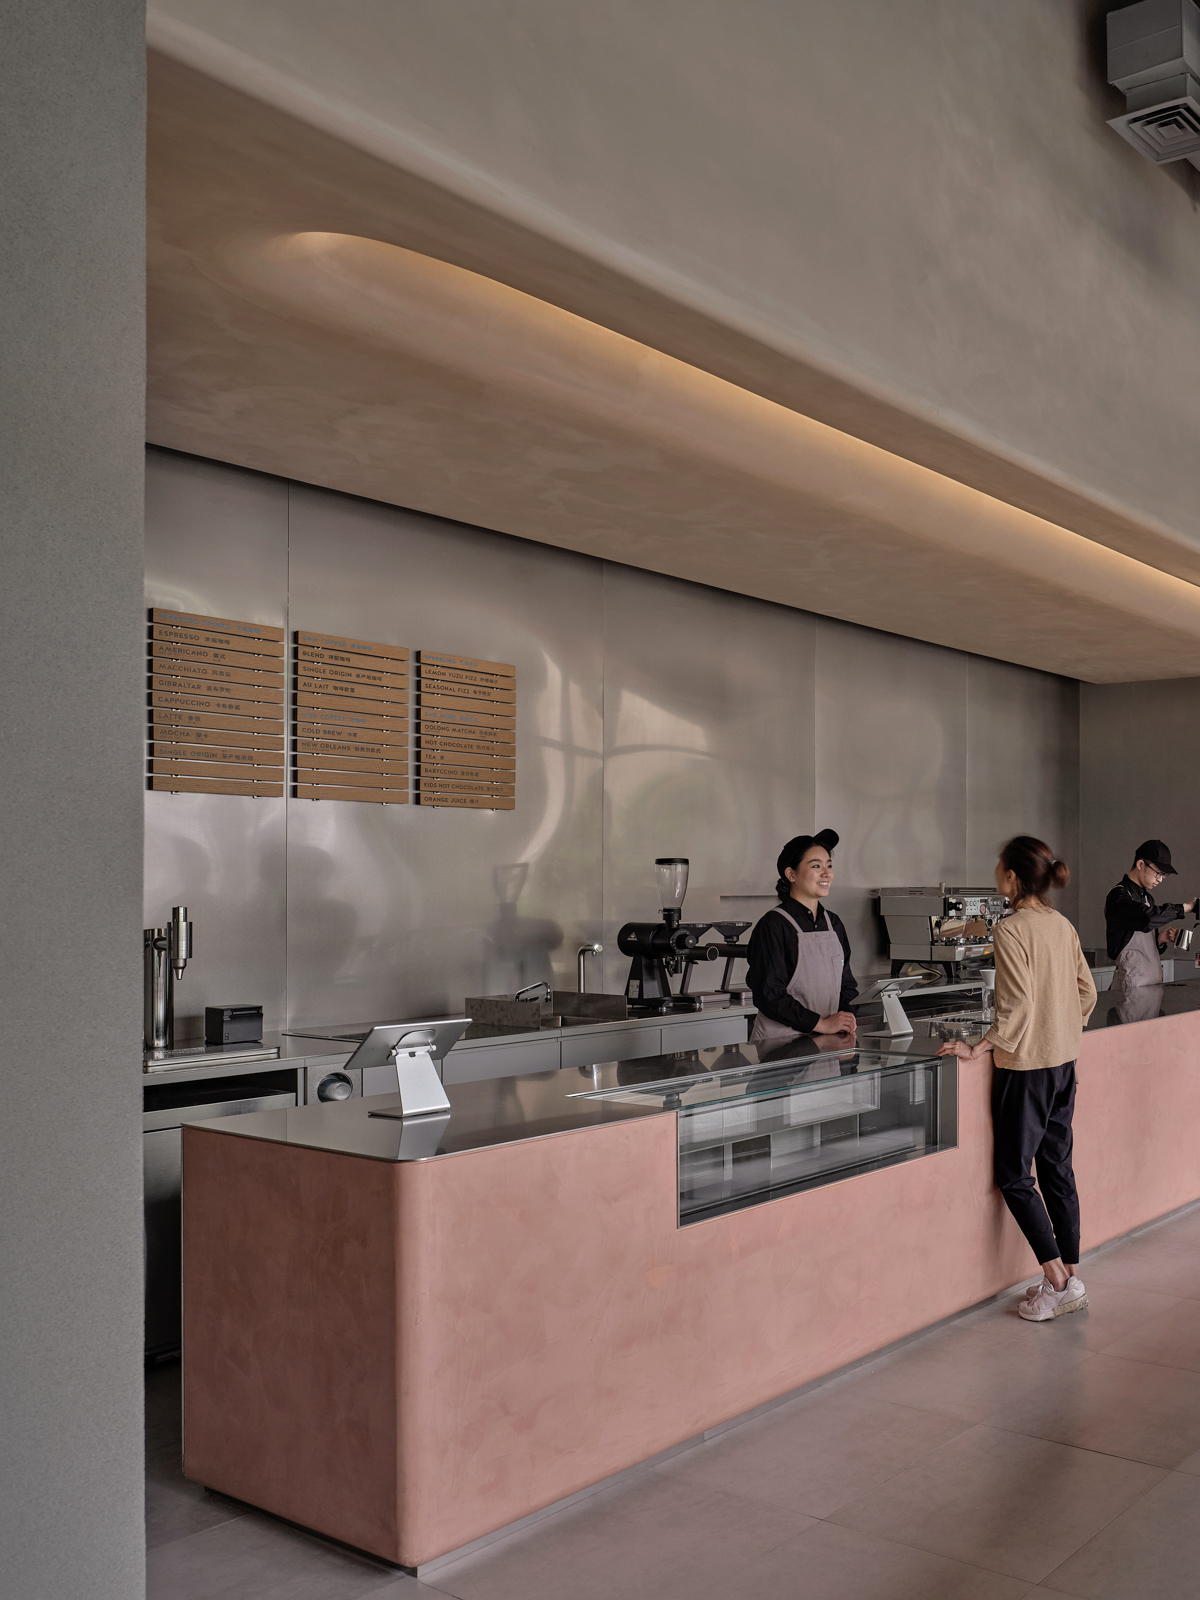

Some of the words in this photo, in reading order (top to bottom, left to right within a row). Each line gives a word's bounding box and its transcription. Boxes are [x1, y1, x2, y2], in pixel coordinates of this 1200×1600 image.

[158, 613, 200, 625] ESPRESSO
[202, 619, 231, 629] DRINKS
[158, 630, 200, 641] ESPRESSO
[321, 638, 347, 647] COFFEE
[158, 646, 209, 657] AMERICANO
[302, 651, 325, 659] BLEND
[424, 654, 456, 664] SPARKLING
[158, 663, 208, 675] MACCHIATO
[303, 666, 327, 674] SINGLE
[329, 669, 352, 677] ORIGIN
[158, 680, 202, 690] GIBRALTAR
[425, 683, 456, 692] SEASONAL
[158, 697, 211, 707] CAPPUCCINO
[159, 712, 183, 720] LATTE
[320, 714, 346, 722] COFFEE
[425, 724, 450, 732] OOLONG
[159, 729, 191, 737] MOCHA
[320, 743, 351, 751] ORLEANS
[439, 741, 473, 749] CHOCOLATE
[159, 748, 187, 756] SINGLE
[425, 768, 458, 776] BABYCCINO
[451, 784, 484, 792] CHOCOLATE
